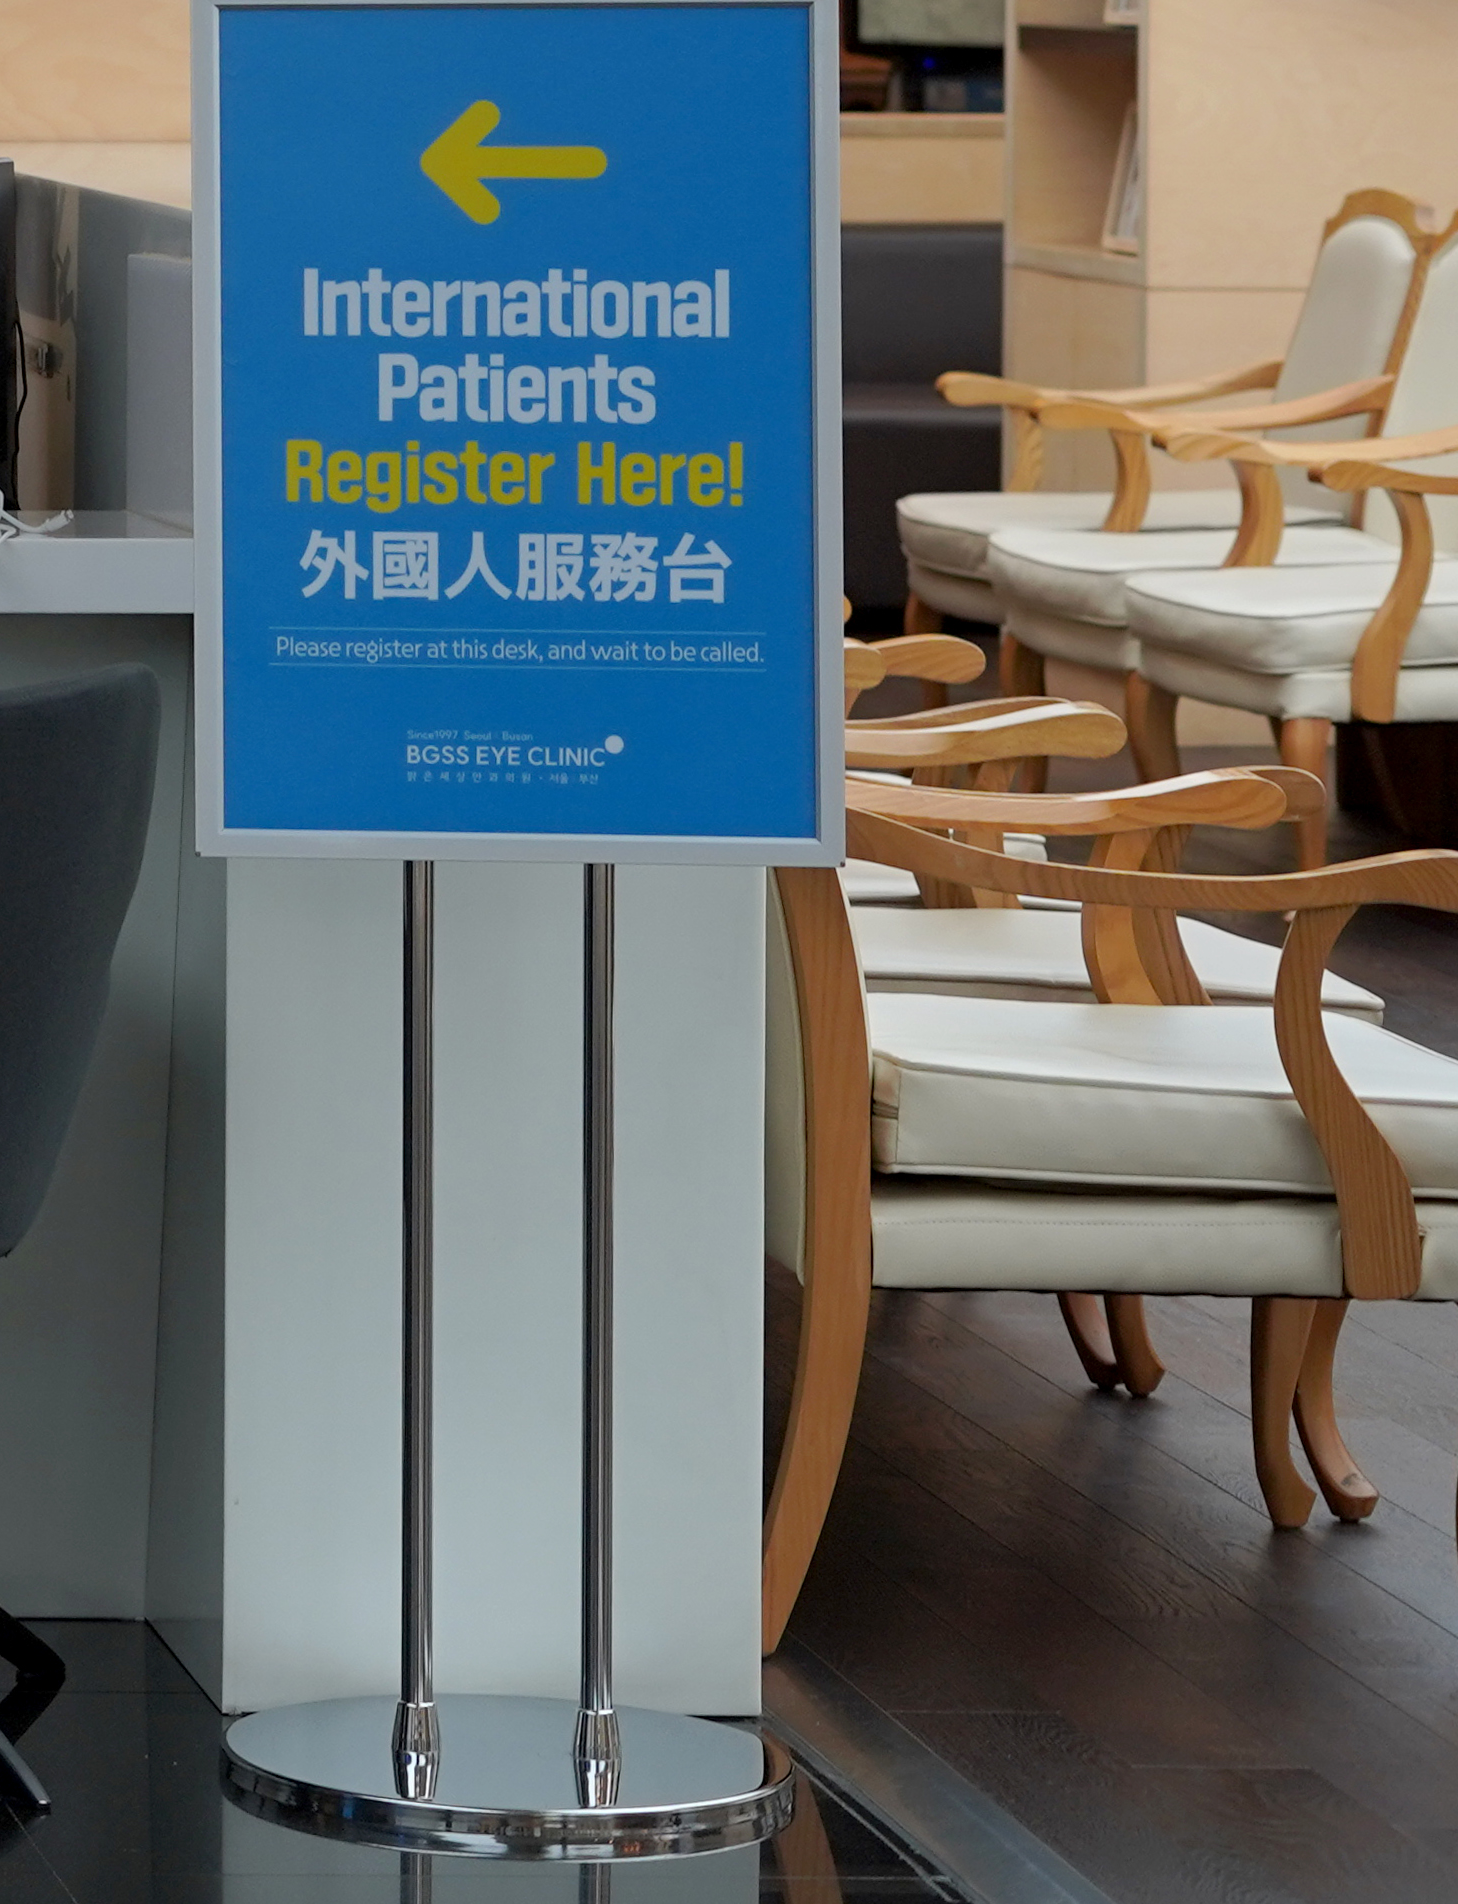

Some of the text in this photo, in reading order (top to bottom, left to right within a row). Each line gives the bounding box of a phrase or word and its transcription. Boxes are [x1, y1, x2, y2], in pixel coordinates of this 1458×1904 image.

[303, 267, 730, 339] International
[378, 352, 657, 425] Patients
[284, 438, 744, 515] Register Here!
[299, 528, 733, 604] 外國人服務台
[274, 636, 764, 667] Please register at this desk, and wait to be called.
[406, 744, 607, 767] BGSS EYE CLINIC
